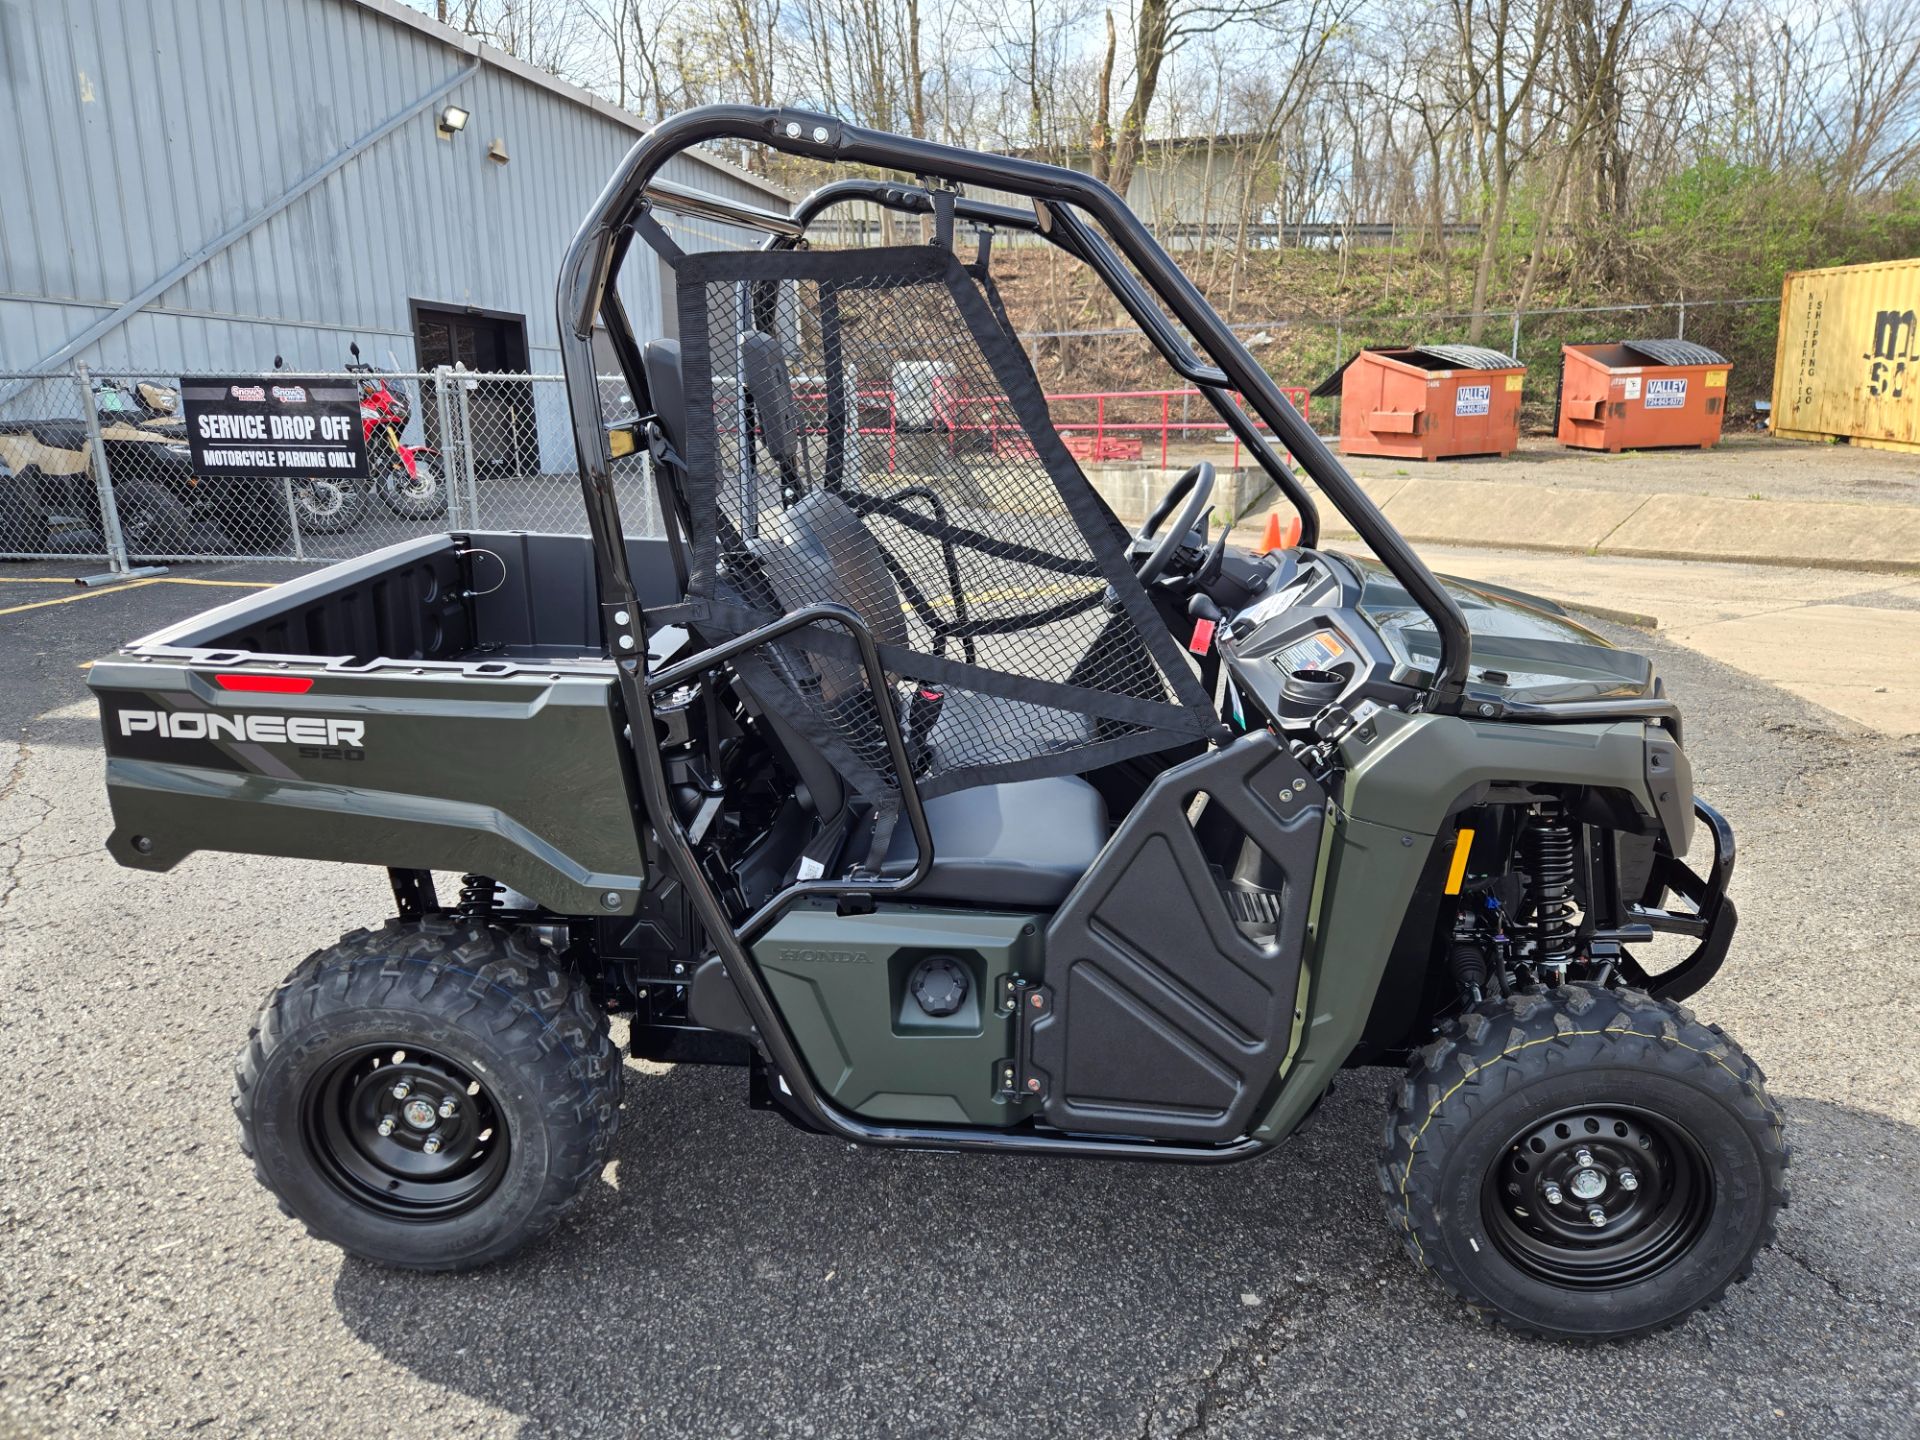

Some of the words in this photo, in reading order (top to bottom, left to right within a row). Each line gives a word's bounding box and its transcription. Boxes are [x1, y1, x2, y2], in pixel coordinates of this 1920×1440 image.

[1807, 300, 1823, 377] SHIPPING
[231, 386, 265, 398] Snow's
[272, 387, 305, 398] Snow's
[1460, 387, 1489, 401] VALLEY
[1649, 380, 1686, 394] VALLEY
[1805, 386, 1813, 405] CO
[198, 414, 267, 439] SERVICE
[269, 415, 315, 440] DROP
[320, 416, 351, 440] OFF
[203, 450, 276, 467] MOTORCYCLE
[278, 451, 327, 467] PARKING
[328, 451, 356, 468] ONLY
[118, 709, 366, 747] PIONEER
[299, 747, 365, 762] 520
[779, 948, 874, 964] HONDA
